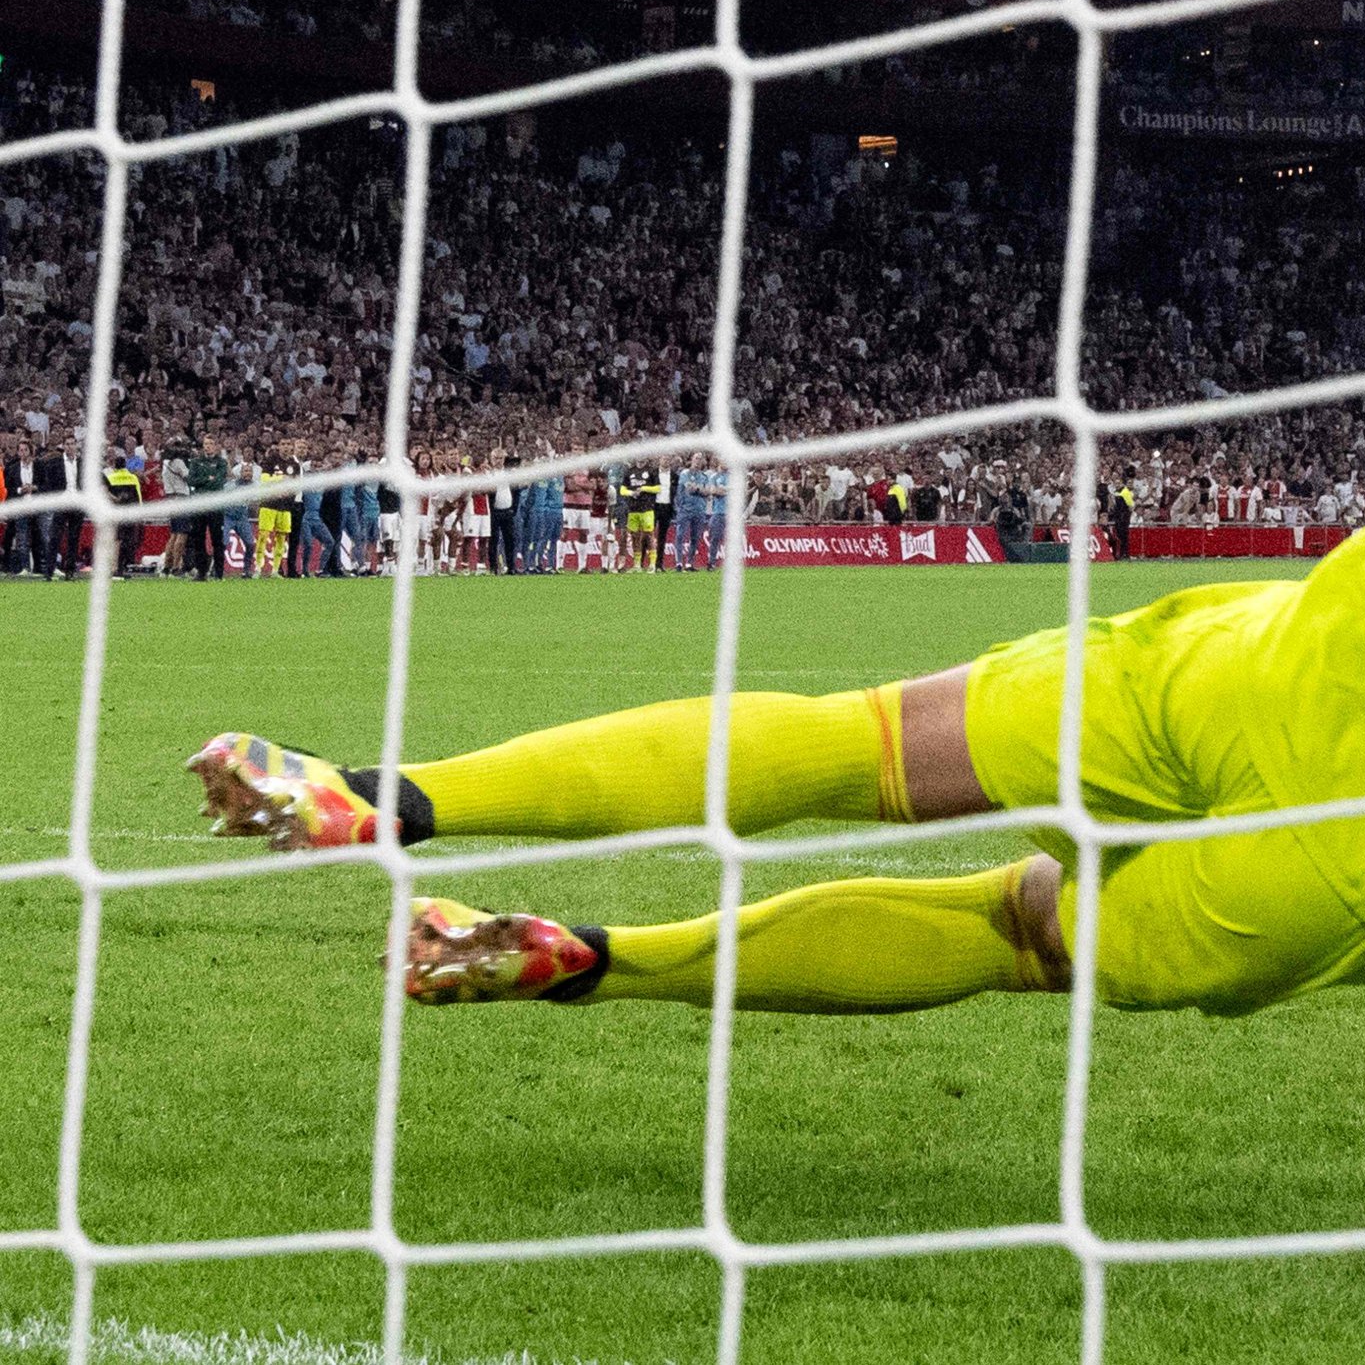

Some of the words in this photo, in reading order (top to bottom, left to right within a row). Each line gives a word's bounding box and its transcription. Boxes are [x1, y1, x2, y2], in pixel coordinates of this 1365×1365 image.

[1118, 104, 1243, 136] Champions
[1247, 109, 1333, 139] Lounge
[763, 537, 829, 555] OLYMPIA
